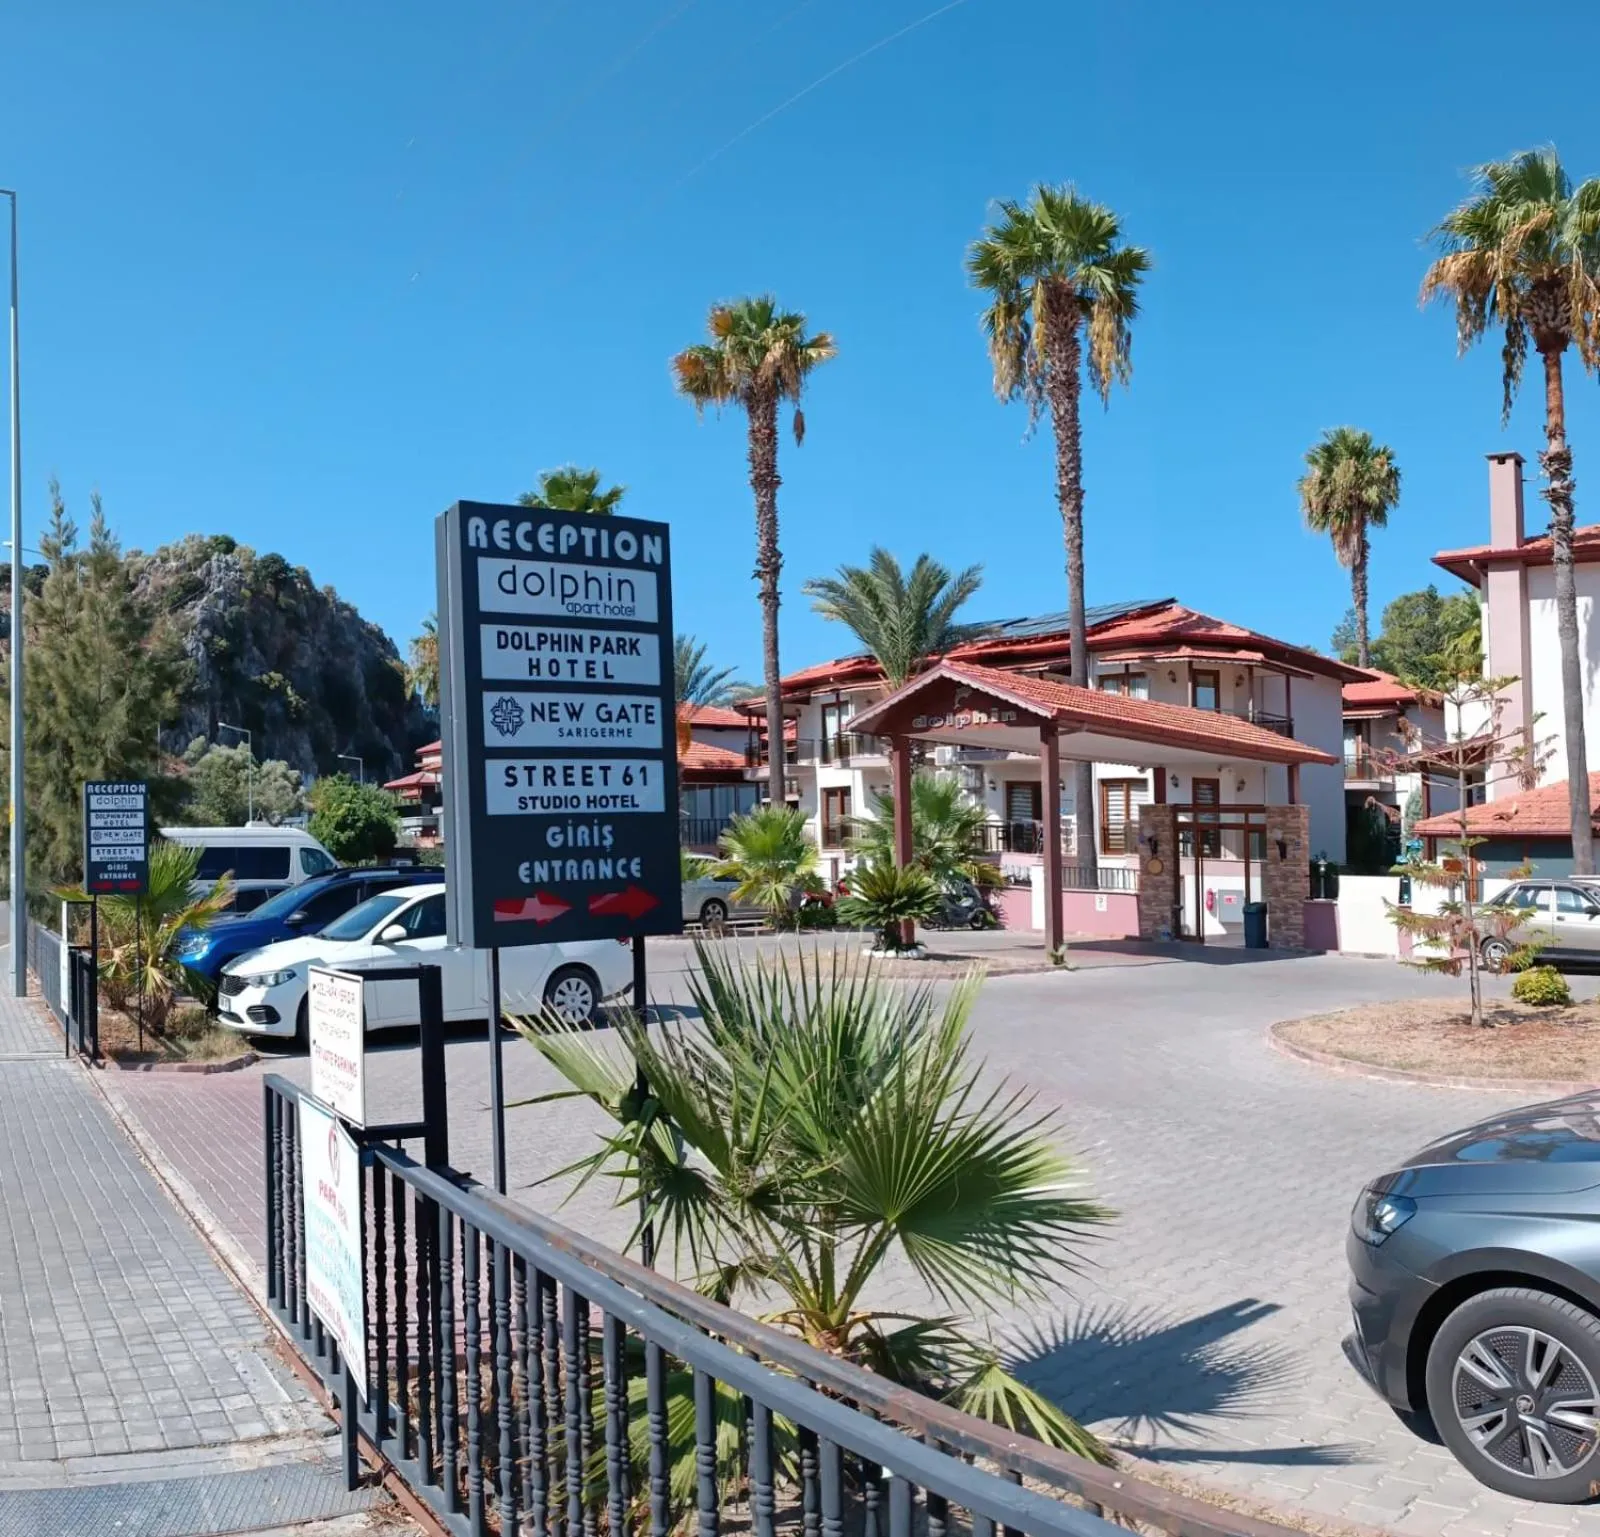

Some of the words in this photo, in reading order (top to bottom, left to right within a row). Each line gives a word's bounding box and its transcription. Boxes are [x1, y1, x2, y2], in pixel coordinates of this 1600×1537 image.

[468, 516, 663, 565] RECEPTION
[497, 565, 636, 605] dolphin
[566, 601, 601, 615] apart
[603, 602, 636, 616] hotel
[496, 630, 584, 653] DOLPHIN
[590, 635, 641, 656] PARK
[528, 658, 614, 679] HOTEL
[531, 702, 585, 723] NEW
[596, 703, 656, 724] GATE
[912, 707, 1017, 729] dolphin
[504, 766, 612, 787] STREET
[622, 766, 648, 786] 61
[88, 784, 146, 793] RECEPTION
[518, 795, 581, 810] STUDIO
[587, 795, 640, 809] HOTEL
[518, 856, 641, 883] ENTRANCE
